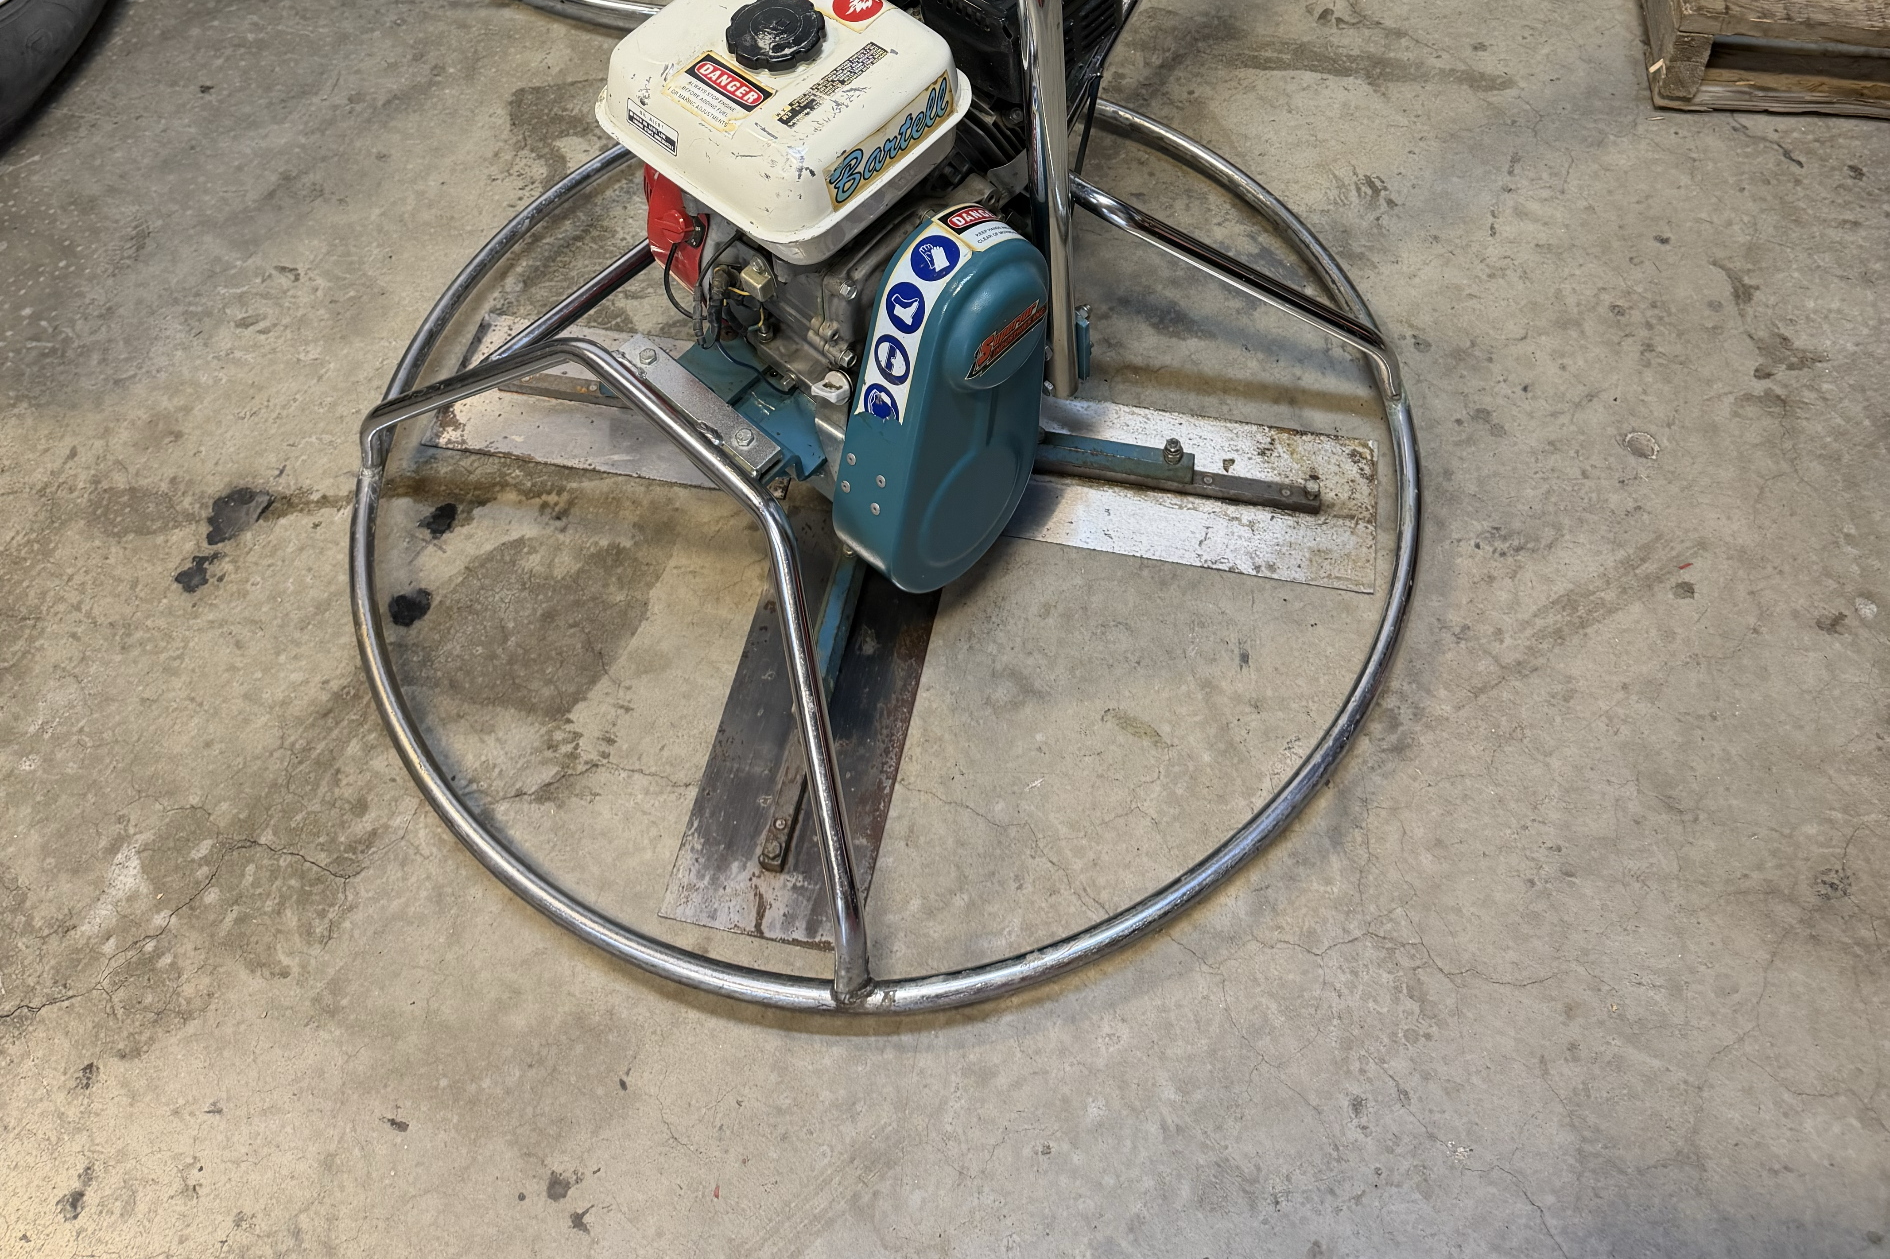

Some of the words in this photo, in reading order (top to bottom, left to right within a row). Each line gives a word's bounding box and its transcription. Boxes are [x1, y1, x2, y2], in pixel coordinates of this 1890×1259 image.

[681, 85, 700, 101] BEFORE
[700, 97, 717, 111] ADDING
[716, 107, 729, 118] FUEL
[688, 81, 708, 95] ALWAYS
[707, 90, 720, 102] STOP
[719, 100, 737, 112] ENGINE
[699, 63, 759, 104] DANGER
[670, 89, 678, 97] OR
[678, 93, 695, 107] MAKING
[695, 103, 728, 128] ADJUSTMENTS
[829, 76, 949, 203] Bartell
